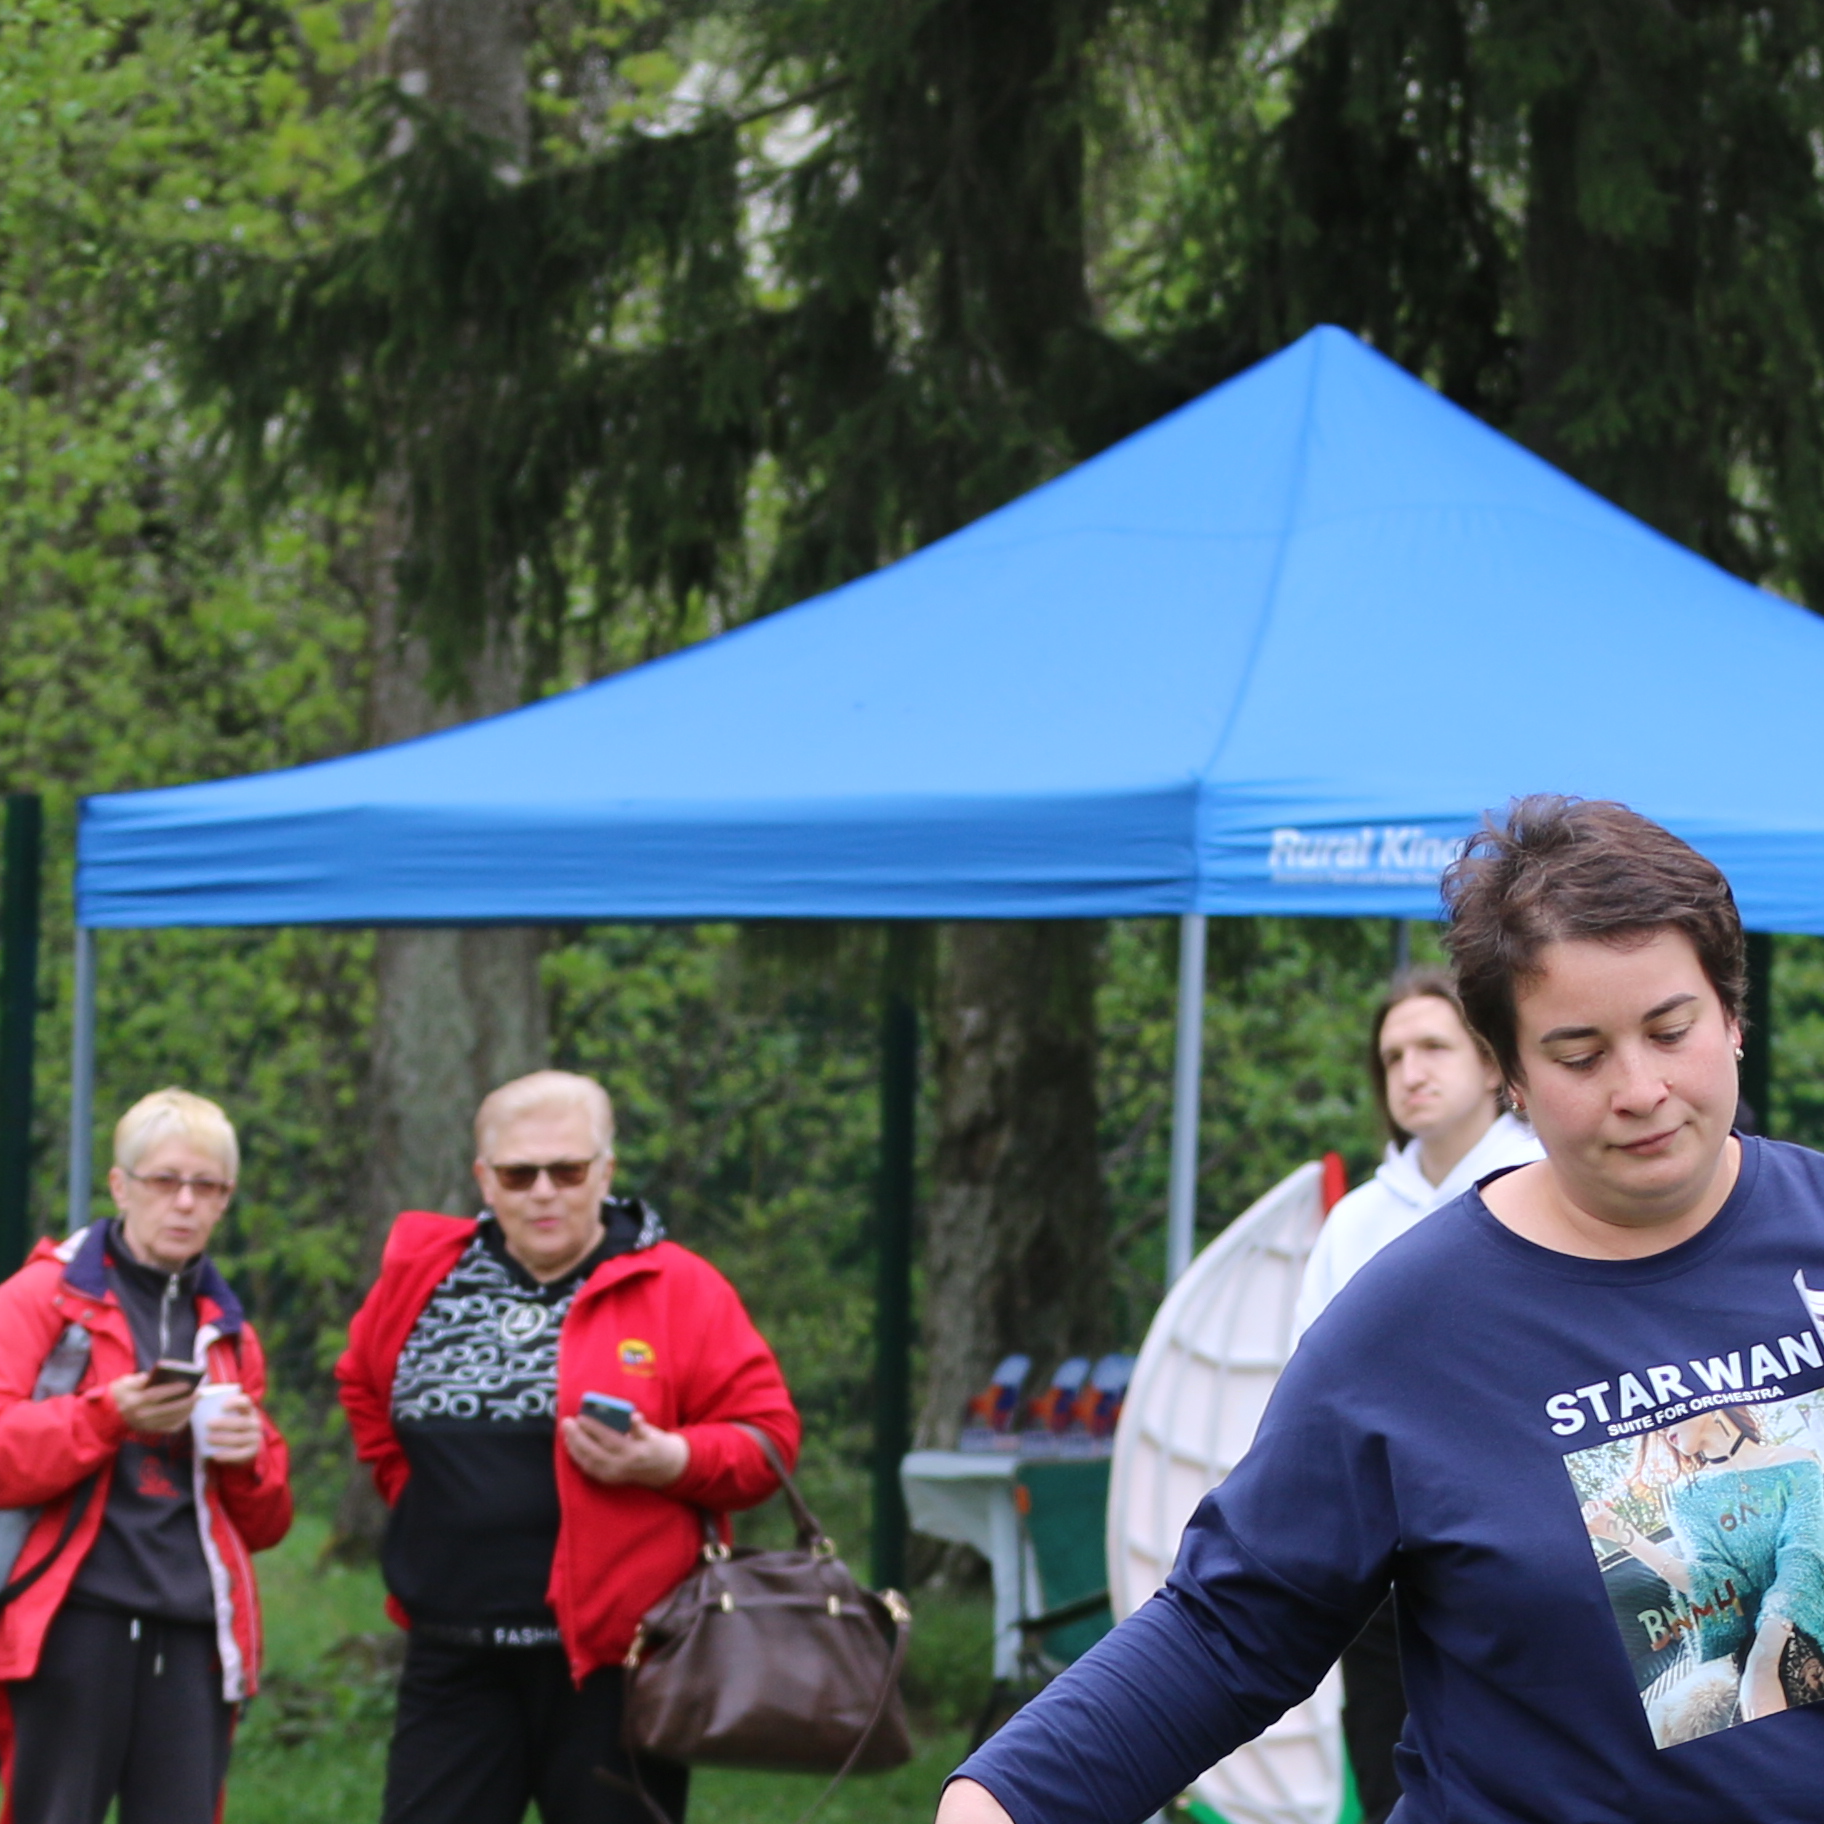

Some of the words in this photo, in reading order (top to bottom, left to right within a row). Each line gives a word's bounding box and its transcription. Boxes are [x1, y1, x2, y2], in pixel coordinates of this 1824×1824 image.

[1270, 828, 1372, 867] Rural
[1545, 1364, 1694, 1436] STAR
[1688, 1331, 1824, 1391] WAN
[1607, 1419, 1655, 1437] SUITE
[1656, 1404, 1689, 1424] FOR
[1689, 1385, 1785, 1412] ORCHESTRA
